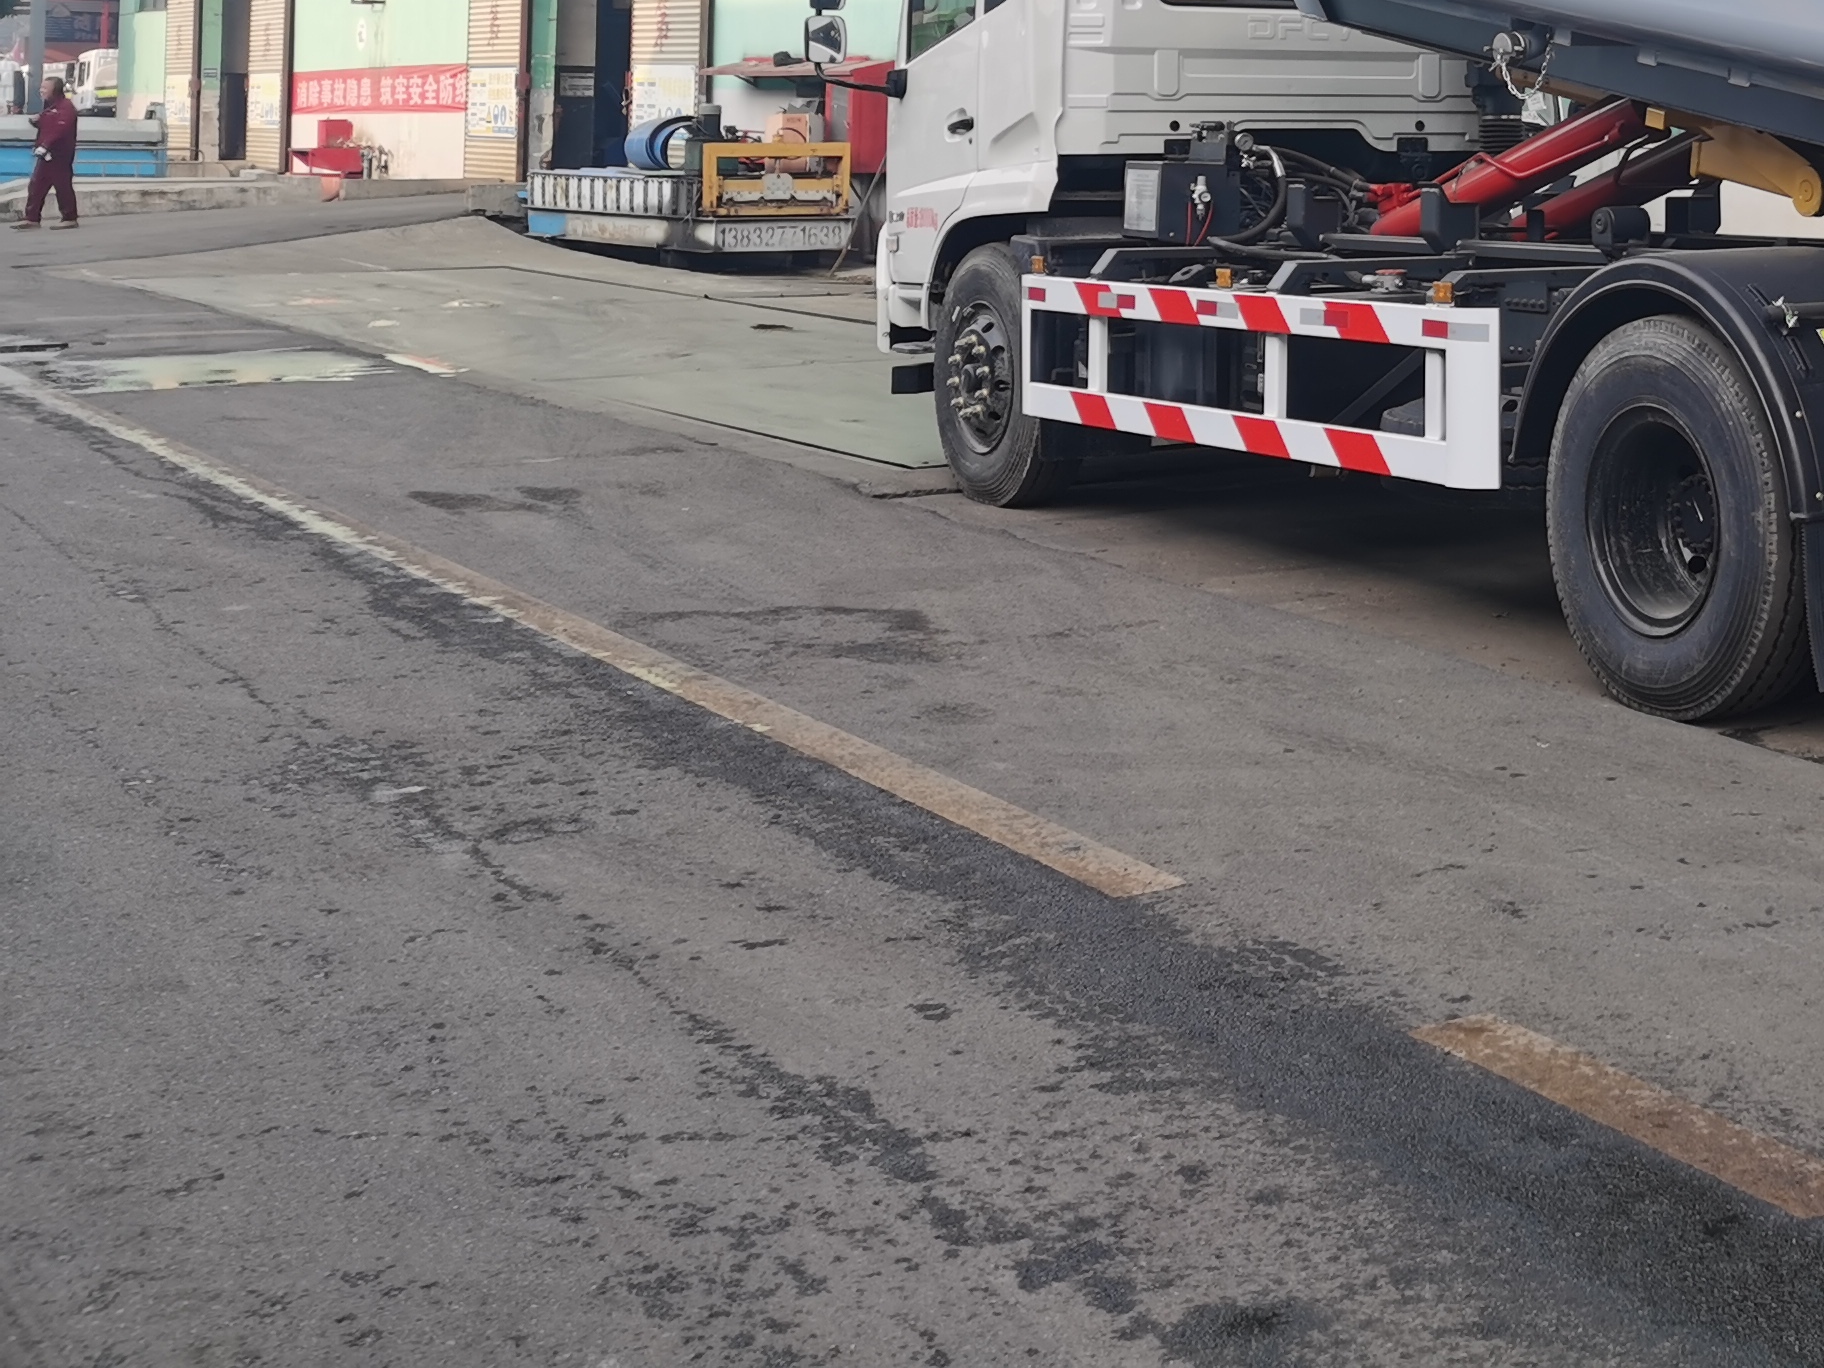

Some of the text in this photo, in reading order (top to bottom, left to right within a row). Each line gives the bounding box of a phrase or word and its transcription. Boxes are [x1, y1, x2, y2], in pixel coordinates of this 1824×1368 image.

[296, 78, 372, 107] 消除事故隐患
[719, 224, 843, 248] 13832771638
